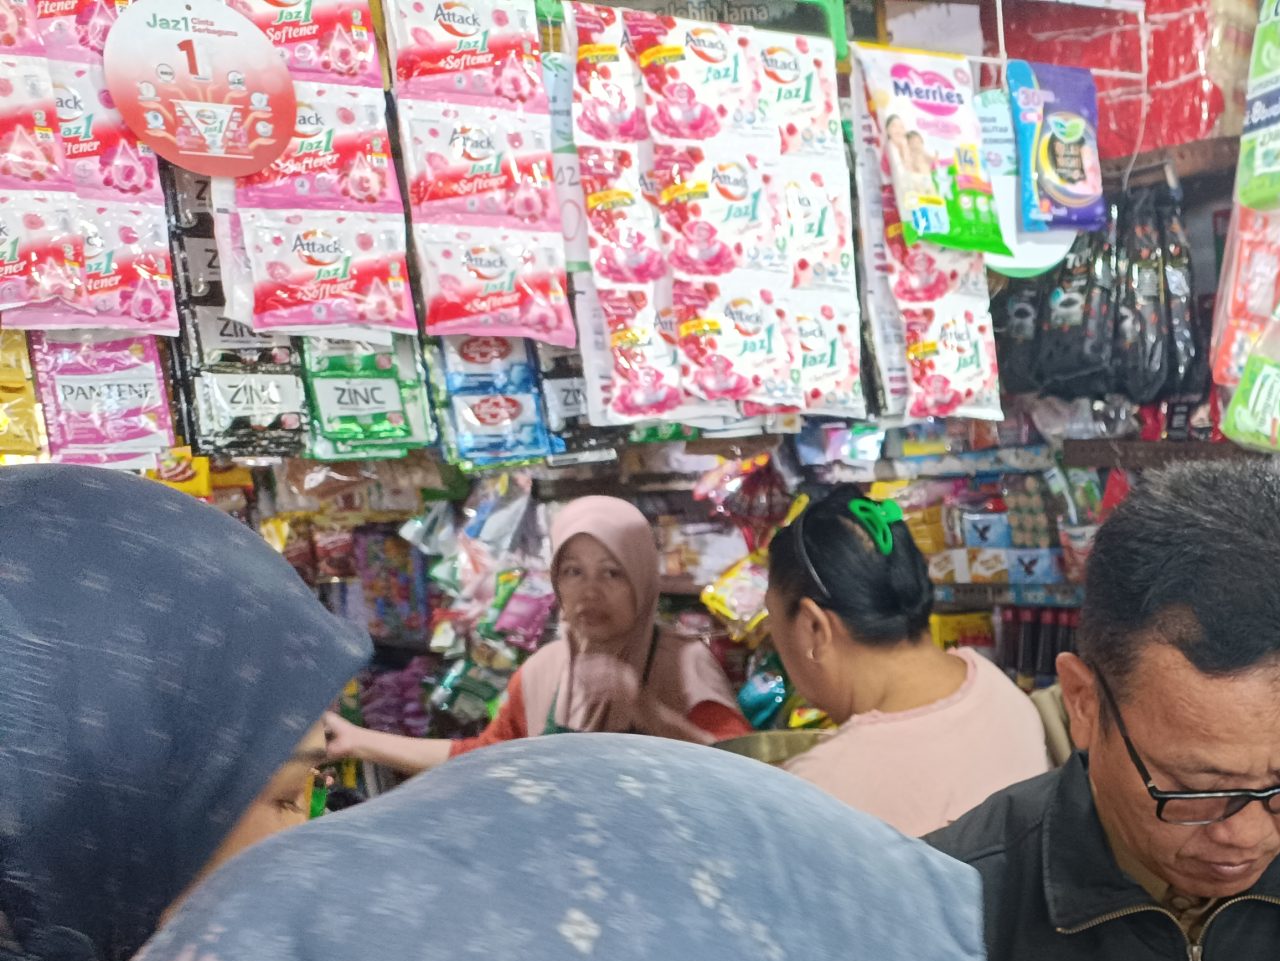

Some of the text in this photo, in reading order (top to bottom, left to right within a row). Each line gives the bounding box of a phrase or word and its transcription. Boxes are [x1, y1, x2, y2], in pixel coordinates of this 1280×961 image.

[146, 13, 190, 32] Jaz1
[433, 3, 482, 27] Attack
[456, 31, 489, 52] Jaz1
[703, 53, 739, 85] Jaz1
[776, 72, 814, 103] Jaz1
[893, 80, 965, 105] Merries
[55, 96, 84, 111] ack
[61, 113, 94, 139] az1
[297, 112, 325, 126] ack
[297, 128, 334, 155] Jaz1
[723, 188, 763, 224] Jaz1
[291, 234, 344, 254] Attack
[316, 255, 353, 281] Jaz1
[61, 382, 155, 402] PANTENE
[333, 386, 386, 406] ZINC
